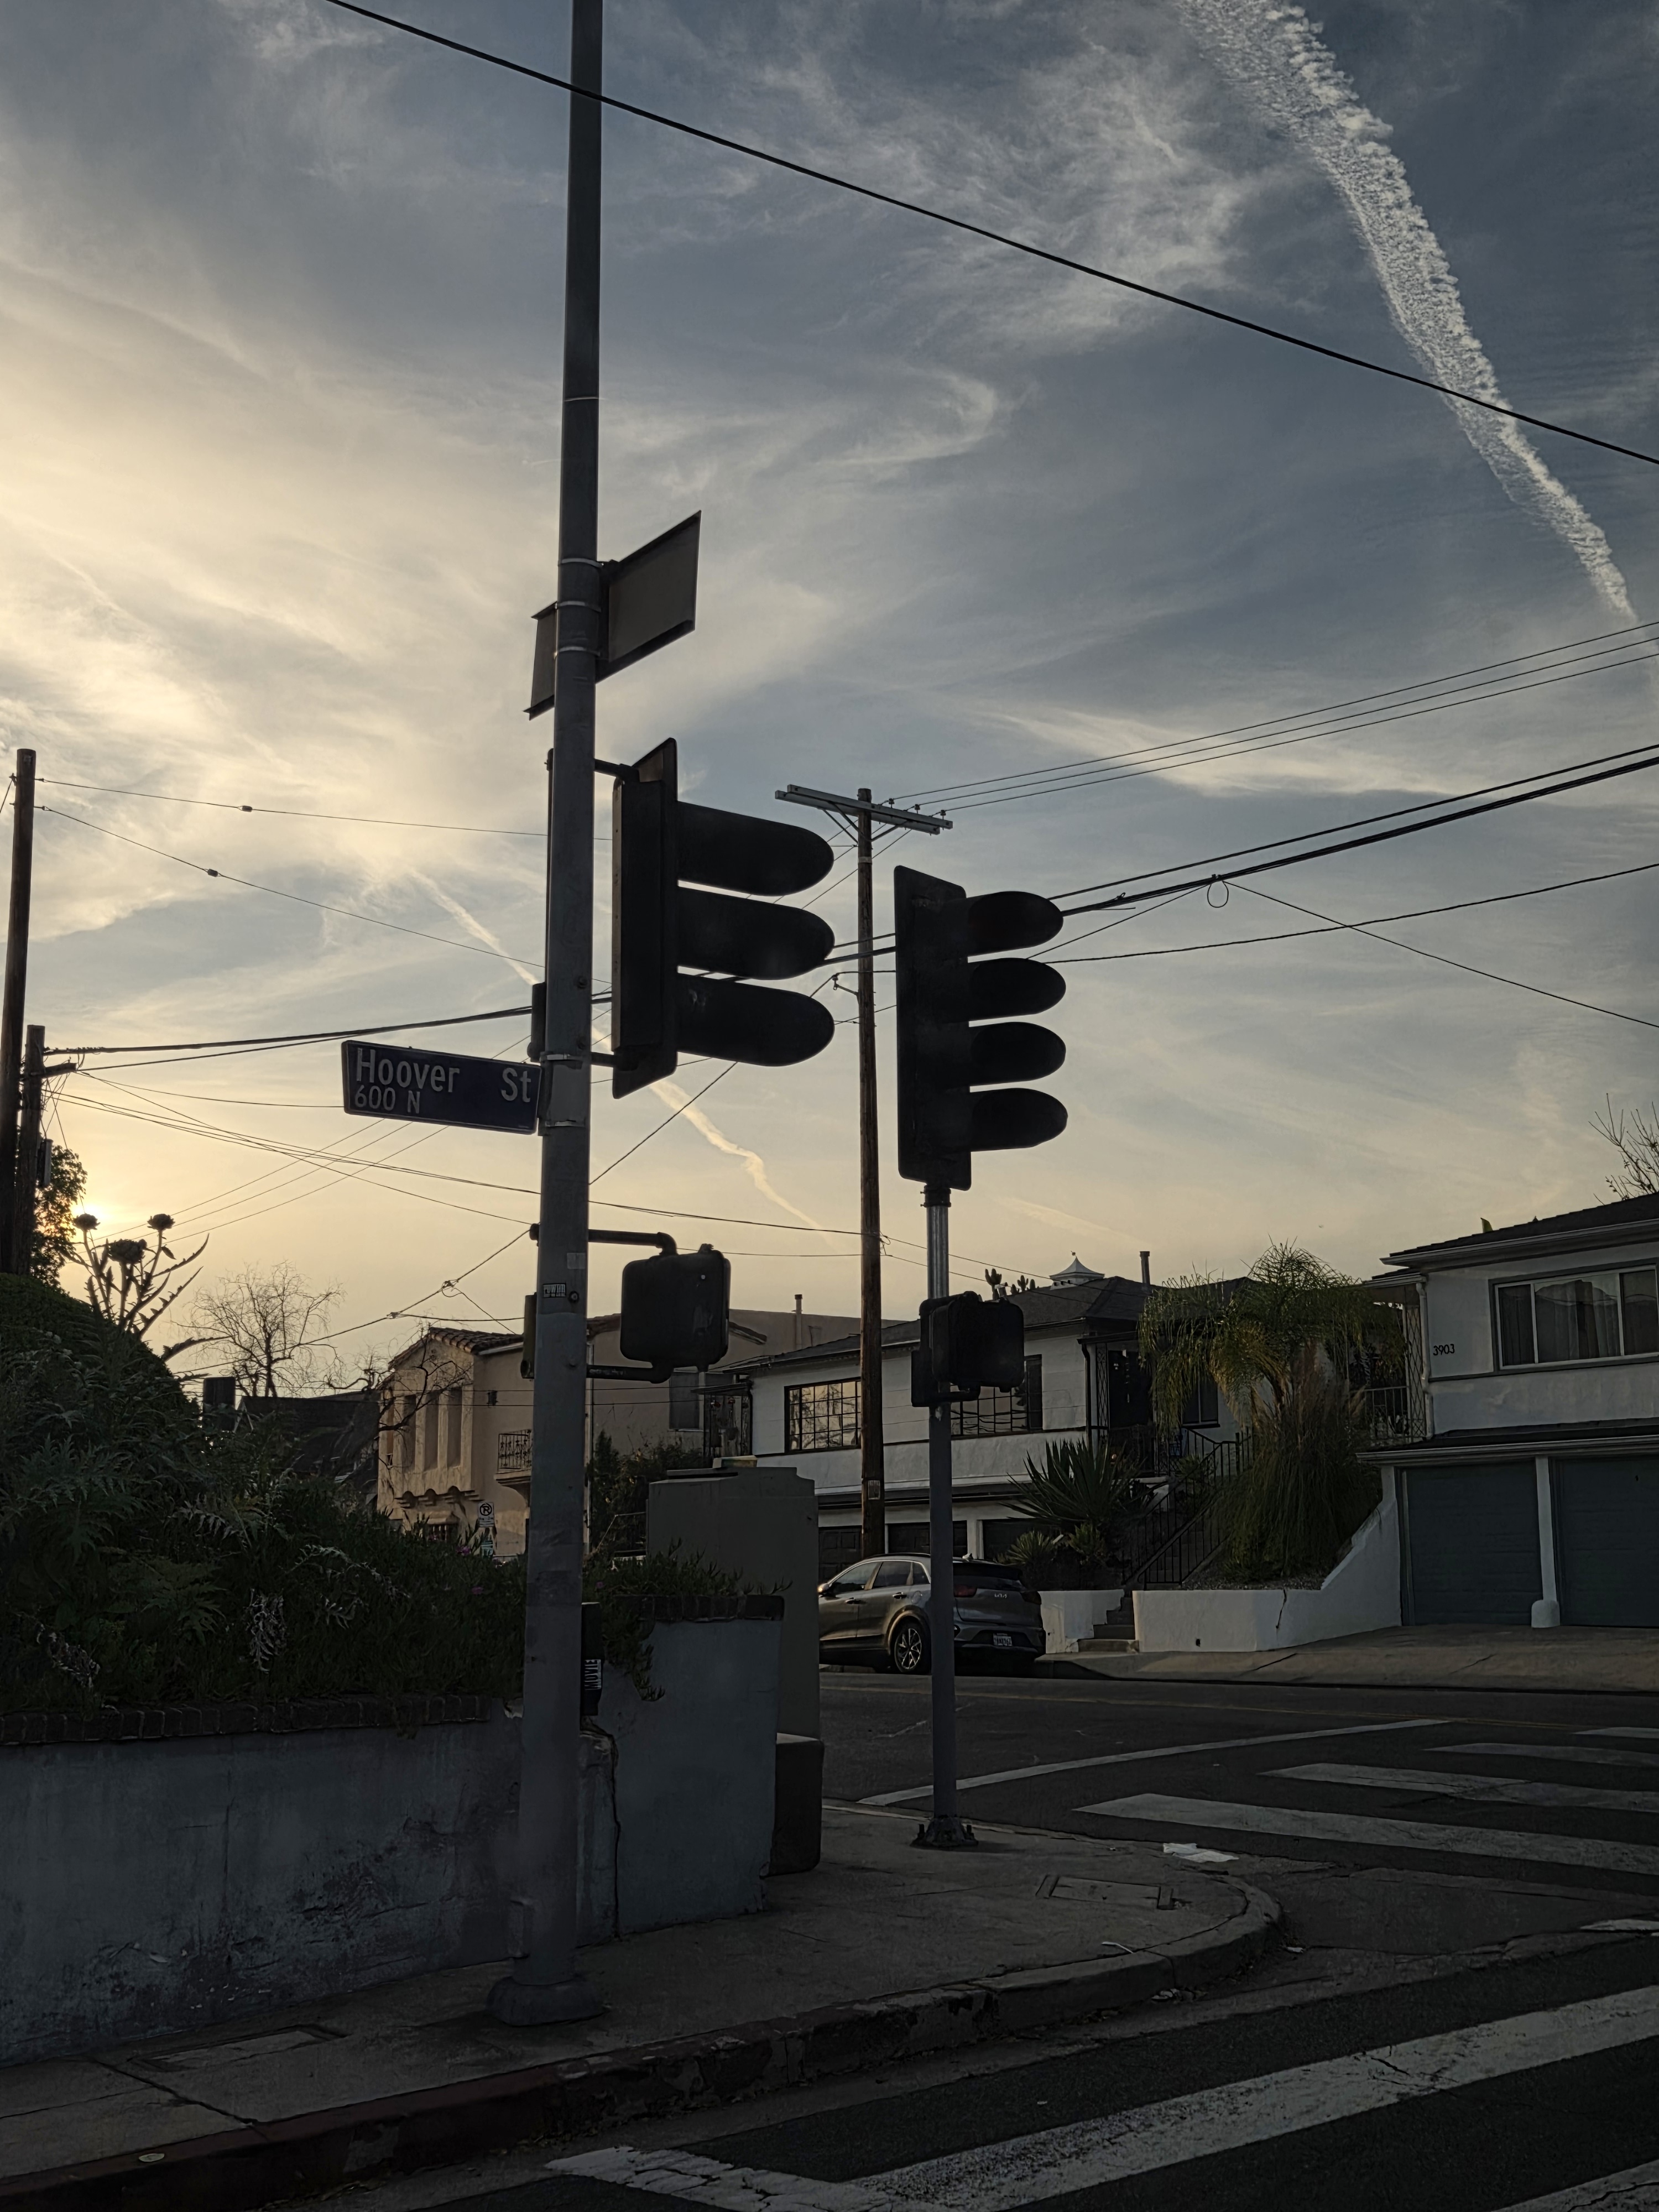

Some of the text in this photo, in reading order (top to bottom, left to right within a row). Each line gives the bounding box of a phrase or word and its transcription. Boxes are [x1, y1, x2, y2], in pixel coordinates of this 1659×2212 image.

[356, 1047, 531, 1103] Hoover St
[354, 1084, 421, 1114] 600 N
[1433, 1343, 1455, 1356] 3903
[585, 1659, 598, 1689] MOVIE
